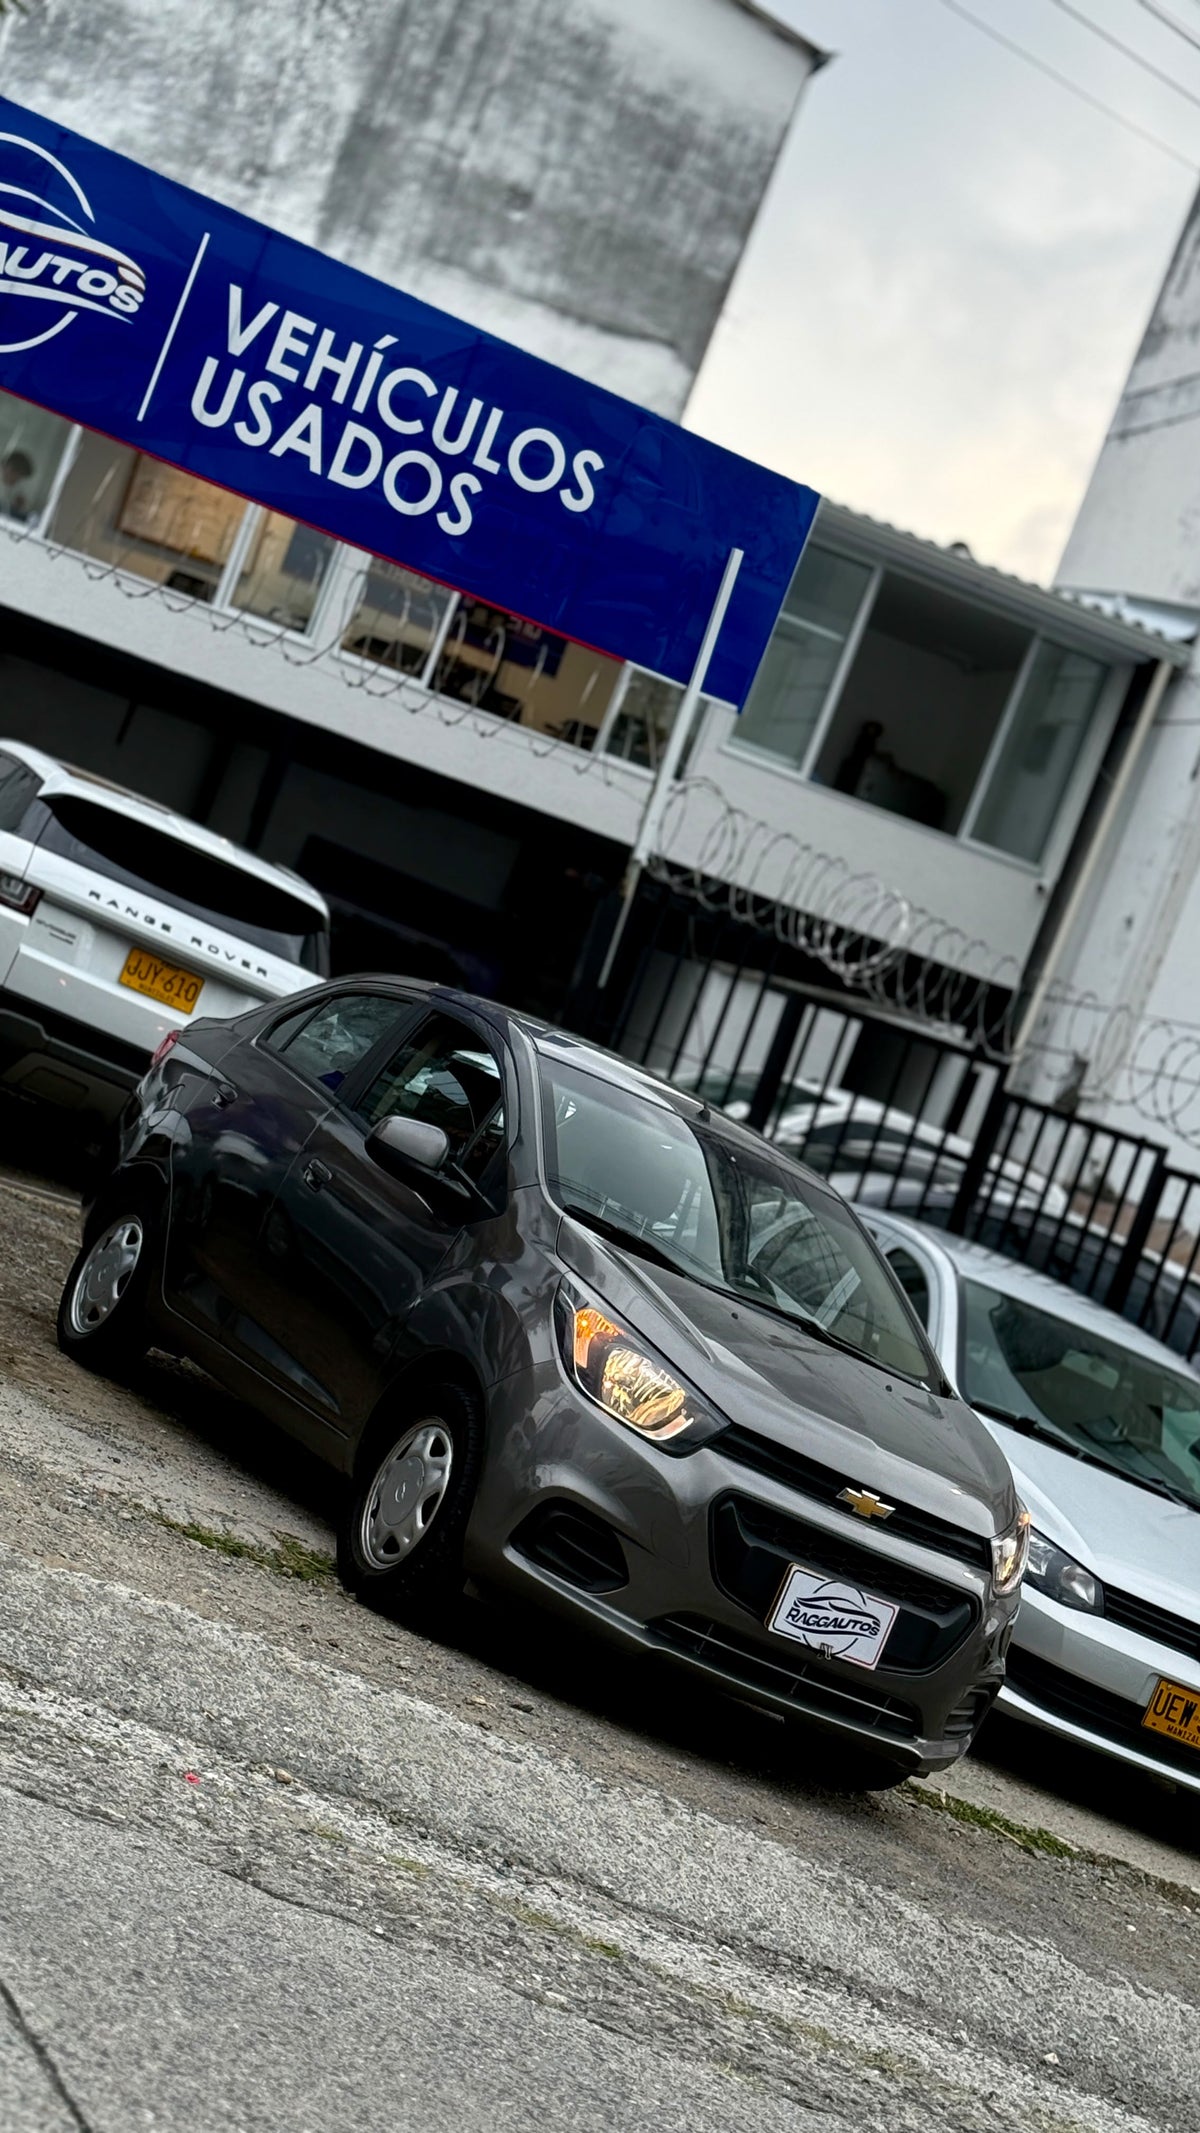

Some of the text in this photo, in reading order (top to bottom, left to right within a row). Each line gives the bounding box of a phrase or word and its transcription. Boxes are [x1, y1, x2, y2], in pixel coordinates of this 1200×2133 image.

[0, 241, 145, 313] UTOS
[228, 283, 605, 512] VEHÍCULOS
[190, 356, 483, 536] USADOS
[88, 889, 172, 933] RANGE
[190, 934, 268, 978] ROVER
[785, 1606, 881, 1637] RAGGAUTOS
